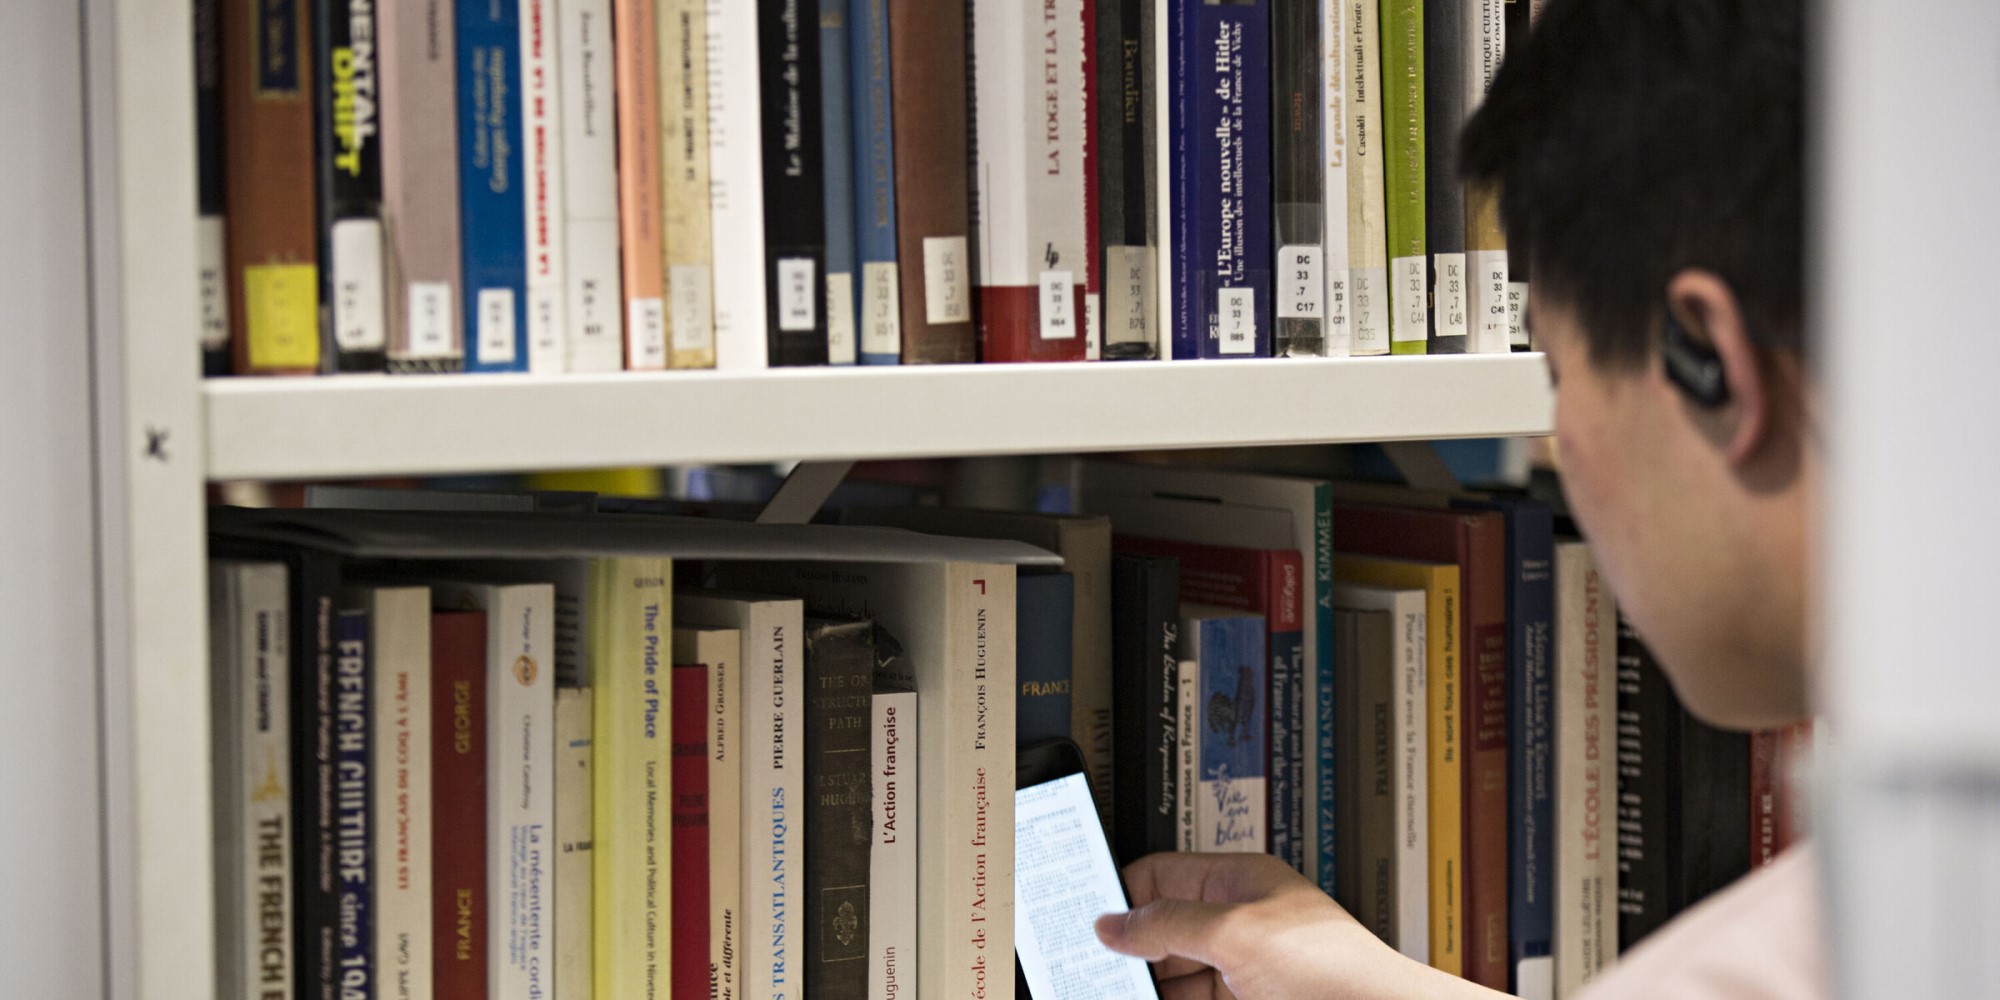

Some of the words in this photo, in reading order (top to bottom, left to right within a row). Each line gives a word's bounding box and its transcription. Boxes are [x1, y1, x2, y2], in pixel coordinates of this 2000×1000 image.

[1353, 2, 1363, 36] Fronte
[1044, 30, 1058, 55] LA
[1213, 21, 1231, 73] Hitler
[1231, 21, 1245, 53] Vichy
[1326, 0, 1344, 89] déculturation
[781, 44, 799, 61] la
[1231, 54, 1243, 68] de
[782, 63, 798, 85] de
[1045, 60, 1058, 85] ET
[1124, 40, 1139, 124] Bourdieu
[1231, 69, 1243, 105] France
[1353, 44, 1366, 103] Intellettuali
[1214, 78, 1231, 100] de
[332, 48, 362, 176] DRIFT
[784, 88, 800, 149] Malaise
[1046, 90, 1060, 144] TOGE
[1231, 106, 1243, 117] la
[1231, 118, 1243, 132] de
[1329, 96, 1346, 133] grande
[1355, 115, 1366, 157] Castoldi
[785, 153, 802, 176] Le
[1047, 150, 1060, 176] LA
[1215, 116, 1231, 193] nouvelle
[1231, 137, 1244, 198] intellectuels
[1330, 145, 1343, 168] La
[533, 125, 550, 248] DESTRUCTION
[1233, 199, 1244, 218] des
[1217, 195, 1235, 277] L'Europe
[1233, 222, 1245, 256] illusion
[1129, 268, 1142, 281] DC
[1234, 259, 1245, 282] Une
[1296, 255, 1311, 265] DC
[1409, 262, 1421, 276] DC
[1447, 264, 1459, 277] DC
[1129, 284, 1141, 297] 33
[1296, 270, 1309, 281] 33
[1333, 280, 1345, 291] DC
[1356, 277, 1369, 291] DC
[1410, 278, 1421, 292] 33
[1448, 279, 1460, 293] 33
[1492, 271, 1504, 281] DC
[1493, 283, 1504, 292] 33
[1230, 297, 1243, 307] DC
[1296, 286, 1306, 297] .7
[1357, 294, 1370, 308] 33
[1411, 295, 1421, 309] .7
[1449, 296, 1459, 310] .7
[1494, 294, 1503, 303] .7
[1509, 291, 1521, 301] DC
[1232, 309, 1242, 319] 33
[1296, 302, 1315, 316] C17
[1332, 314, 1346, 326] C21
[1358, 311, 1370, 325] .7
[1410, 310, 1425, 324] C44
[1509, 303, 1520, 312] 33
[1357, 327, 1376, 343] C35
[1316, 508, 1331, 582] KIMMEL
[1282, 563, 1297, 625] palgrave
[1318, 589, 1331, 609] A.
[643, 602, 660, 632] The
[1405, 612, 1417, 644] Pour
[1442, 597, 1455, 653] humains
[972, 608, 988, 680] HUGUENIN
[1162, 620, 1179, 650] The
[1533, 621, 1549, 678] Mona
[1577, 569, 1601, 709] PRÉSIDENTS
[642, 635, 660, 677] Pride
[771, 625, 785, 708] GUERLAIN
[1272, 655, 1288, 670] of
[1406, 647, 1415, 664] en
[1443, 655, 1454, 680] ces
[643, 679, 660, 696] of
[714, 661, 726, 715] GROSSER
[819, 675, 844, 690] THE
[1022, 679, 1071, 698] FRANCE
[1162, 653, 1178, 704] Burden
[1181, 677, 1192, 685] 1
[1273, 671, 1287, 719] France
[1442, 682, 1454, 711] fous
[453, 678, 471, 755] GEORGE
[642, 698, 660, 739] Place
[828, 716, 863, 731] PATH
[973, 684, 991, 751] FRANÇOIS
[1159, 706, 1177, 721] of
[1181, 704, 1194, 747] France
[1320, 682, 1335, 754] FRANCE
[1406, 698, 1416, 726] avec
[521, 714, 533, 762] Christine
[714, 717, 727, 763] ALFRED
[771, 712, 784, 770] PIERRE
[882, 706, 900, 777] française
[1272, 720, 1288, 753] after
[1406, 730, 1417, 745] la
[1443, 715, 1454, 743] sont
[1583, 713, 1601, 761] DES
[396, 731, 411, 764] COQ
[1182, 749, 1192, 766] en
[1291, 732, 1302, 759] and
[396, 768, 409, 790] DU
[646, 760, 660, 789] Local
[1158, 724, 1178, 816] Responsibility
[1273, 755, 1287, 779] the
[1406, 746, 1418, 791] France
[1533, 741, 1549, 801] Escort
[518, 764, 533, 810] Geoffroy
[1182, 769, 1192, 807] masse
[1320, 768, 1334, 801] DIT
[645, 790, 659, 844] Memories
[882, 781, 897, 844] L'Action
[970, 767, 990, 847] française
[1181, 812, 1194, 827] de
[1273, 780, 1288, 830] Second
[1579, 768, 1601, 861] L'ÉCOLE
[259, 815, 285, 869] THE
[396, 793, 411, 864] FRANÇAIS
[529, 824, 545, 844] La
[1215, 819, 1255, 846] bleu
[1320, 807, 1334, 856] AVEZ
[646, 845, 660, 867] and
[397, 865, 410, 891] LES
[645, 868, 660, 910] Political
[770, 786, 788, 988] TRANSATLANTIQUES
[970, 853, 988, 923] l'Action
[528, 849, 546, 951] mésentente
[259, 876, 287, 984] FRENCH
[338, 891, 365, 948] since
[455, 888, 474, 961] FRANCE
[646, 911, 660, 949] Culture
[721, 907, 735, 969] différente
[970, 928, 987, 950] de
[646, 951, 659, 963] in
[722, 970, 733, 983] et
[883, 946, 900, 1000] uguenin
